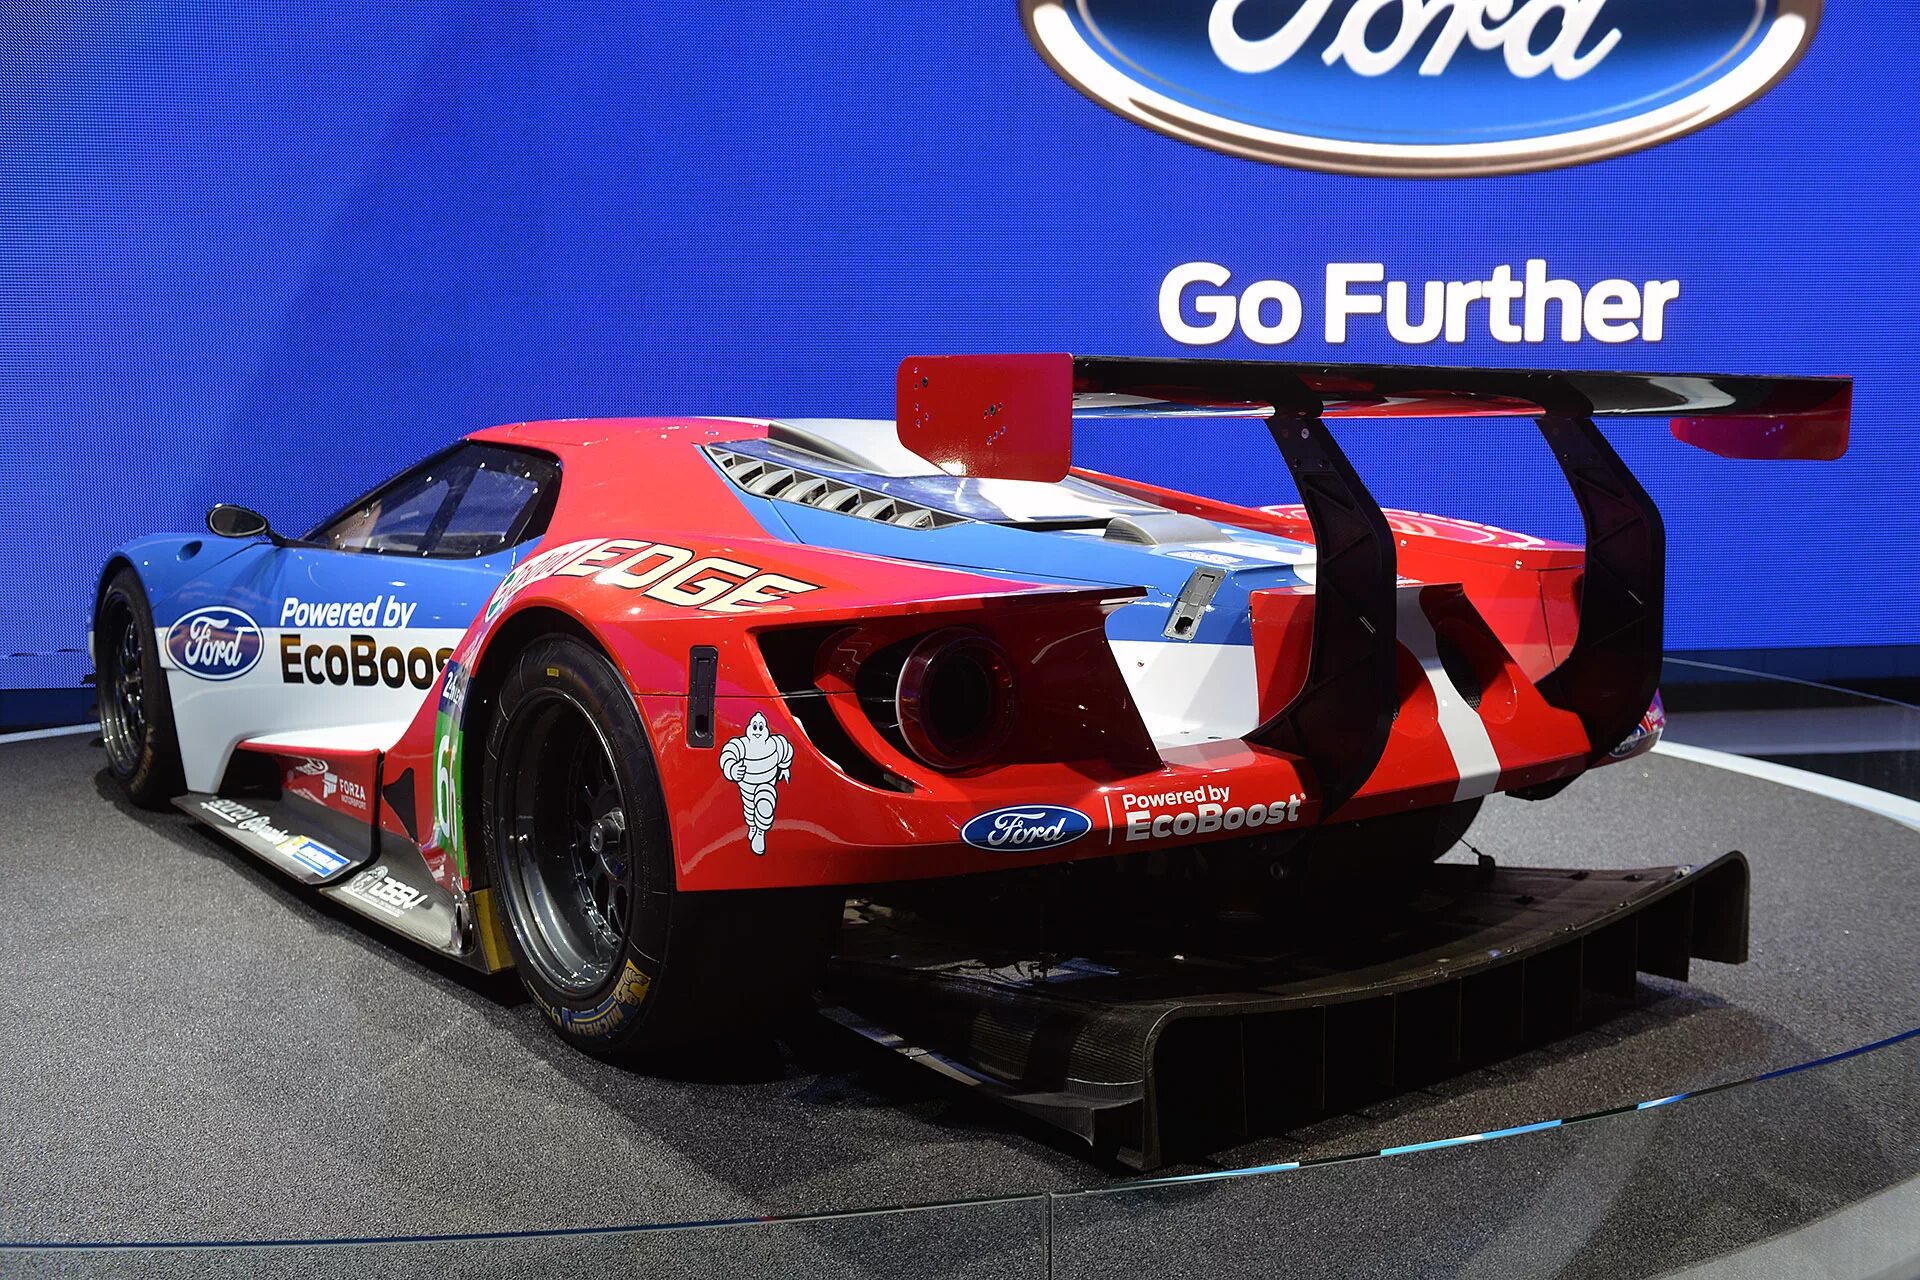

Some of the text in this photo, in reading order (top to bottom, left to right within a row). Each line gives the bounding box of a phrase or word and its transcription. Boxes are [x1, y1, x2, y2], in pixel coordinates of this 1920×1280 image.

[1158, 258, 1680, 345] Go Further
[555, 539, 826, 614] EDGE
[280, 595, 417, 629] Powered by
[185, 616, 246, 667] Ford
[339, 779, 366, 801] FORZA
[1122, 784, 1230, 810] Powered by
[987, 812, 1067, 846] Ford
